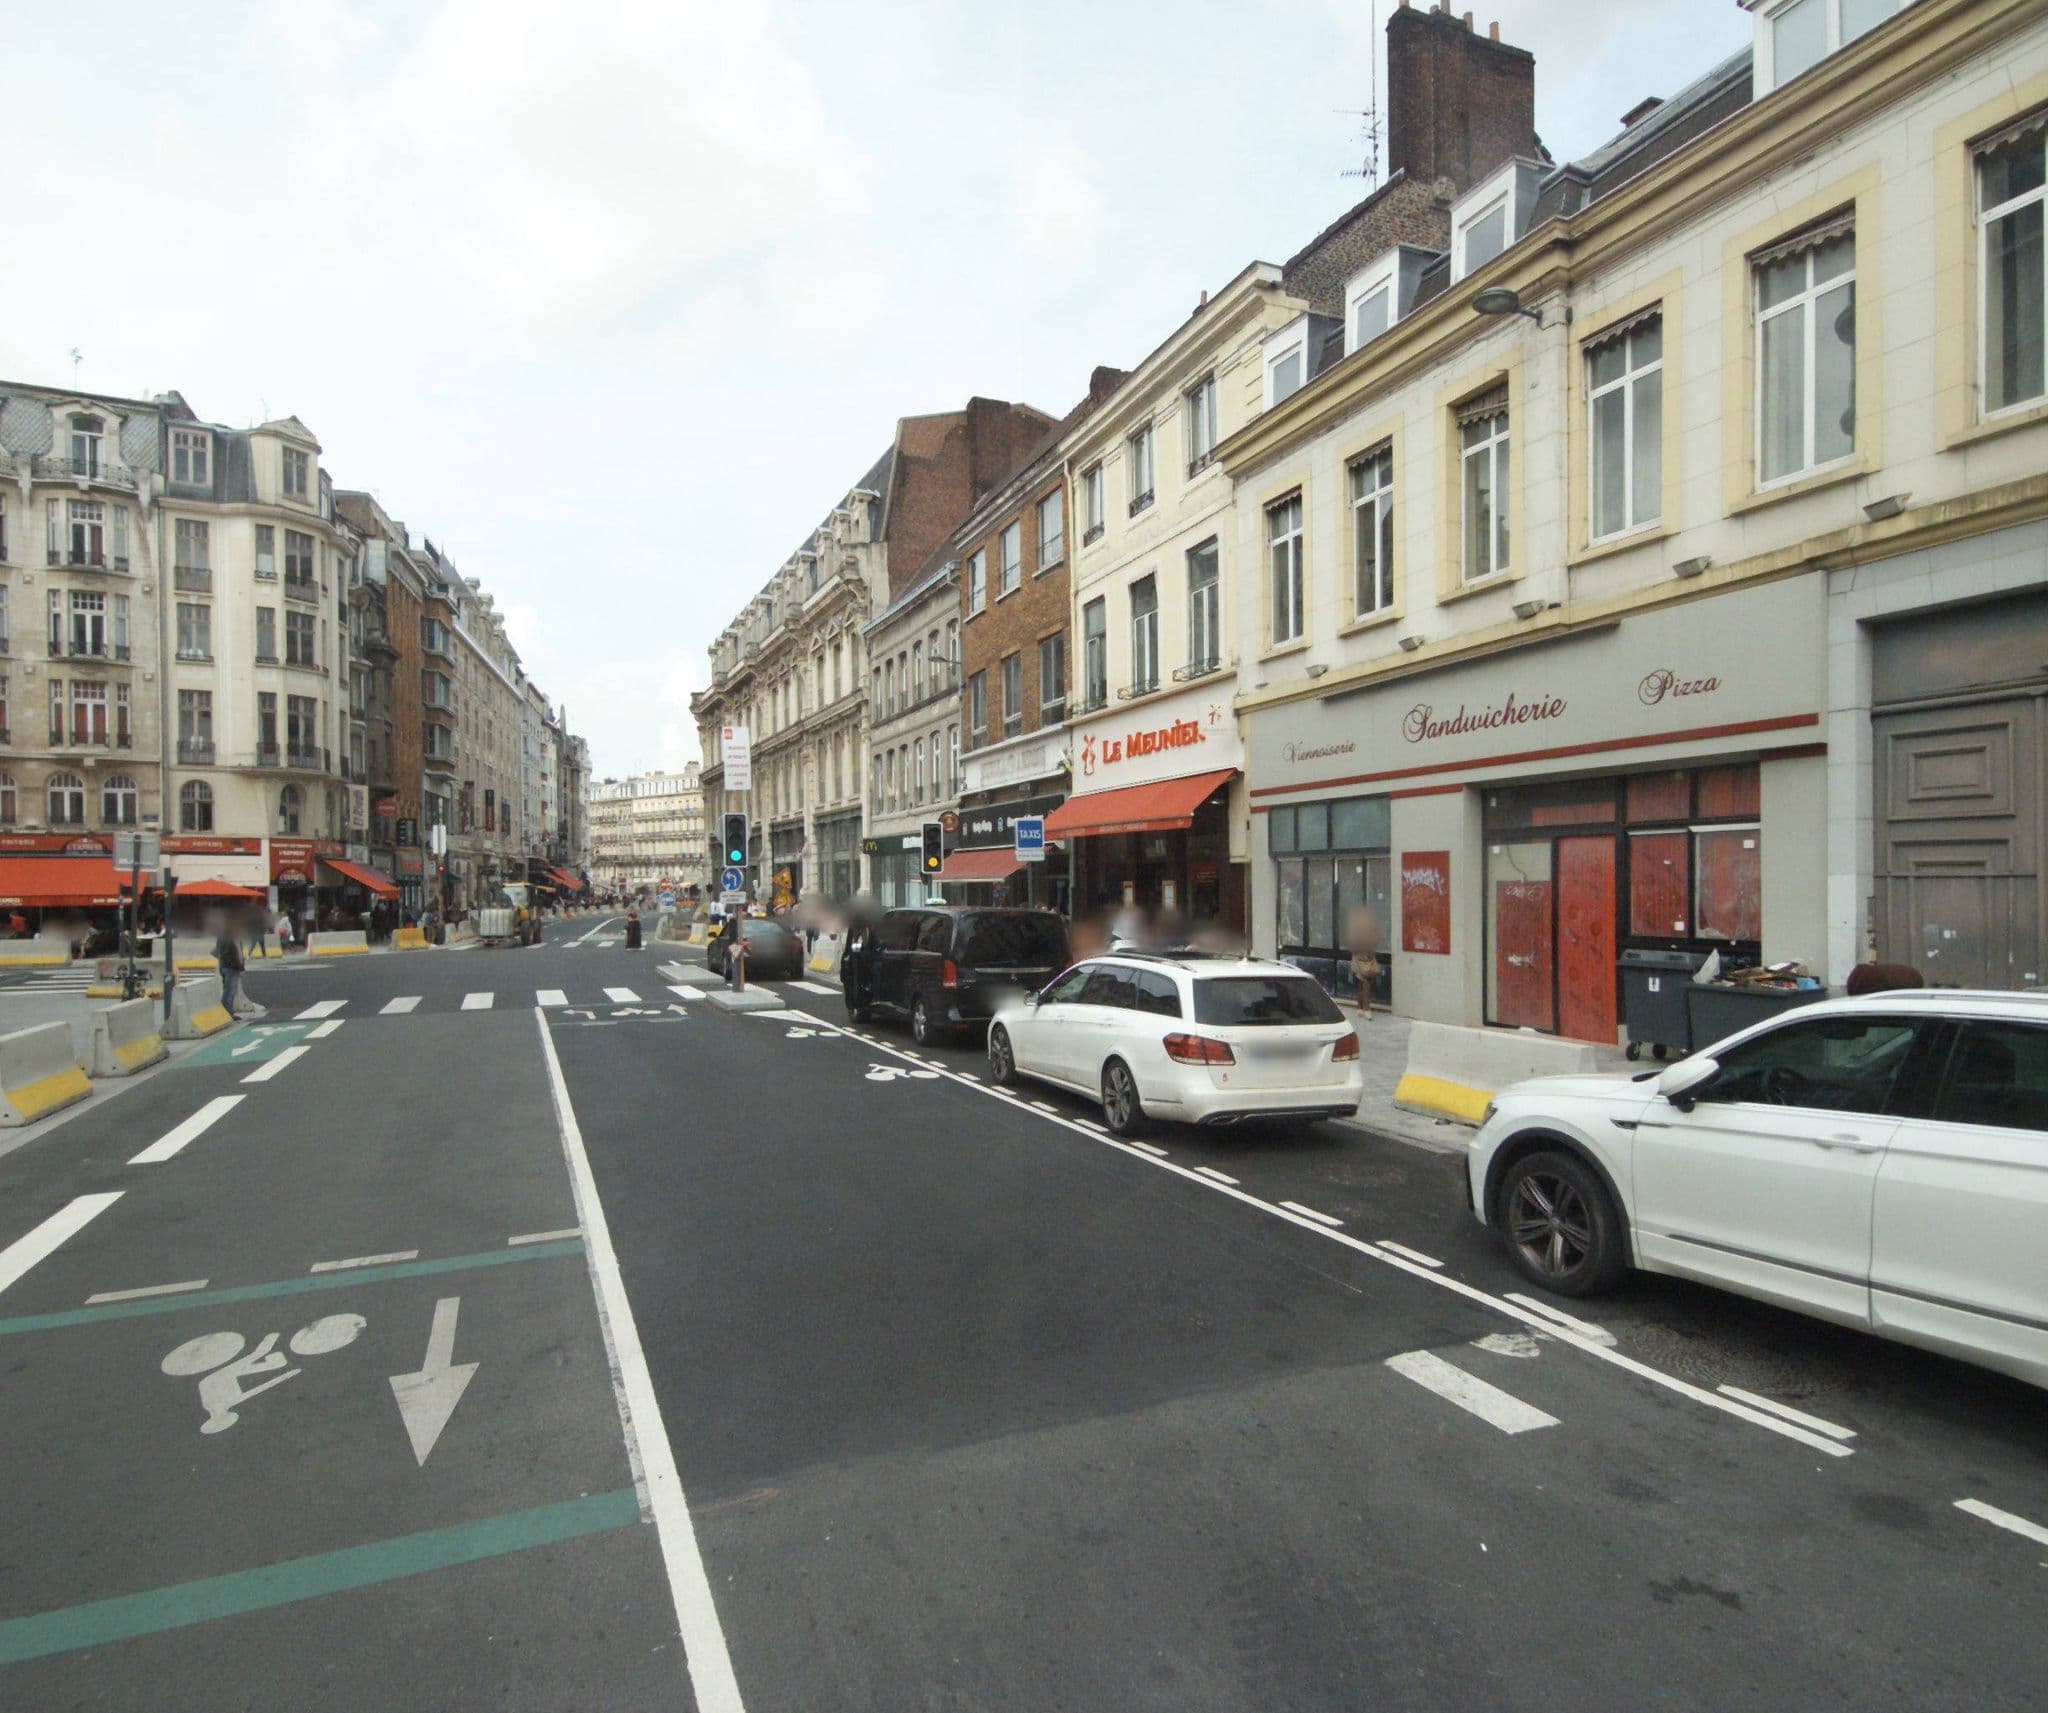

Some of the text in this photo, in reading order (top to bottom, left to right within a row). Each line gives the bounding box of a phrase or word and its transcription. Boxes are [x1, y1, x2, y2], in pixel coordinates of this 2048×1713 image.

[1639, 668, 1721, 706] Pizza
[1403, 692, 1567, 743] Sandwicherie
[1102, 719, 1206, 764] LE MEUNIER
[1283, 742, 1357, 763] Viennoiserie
[1020, 829, 1041, 839] TAXIS
